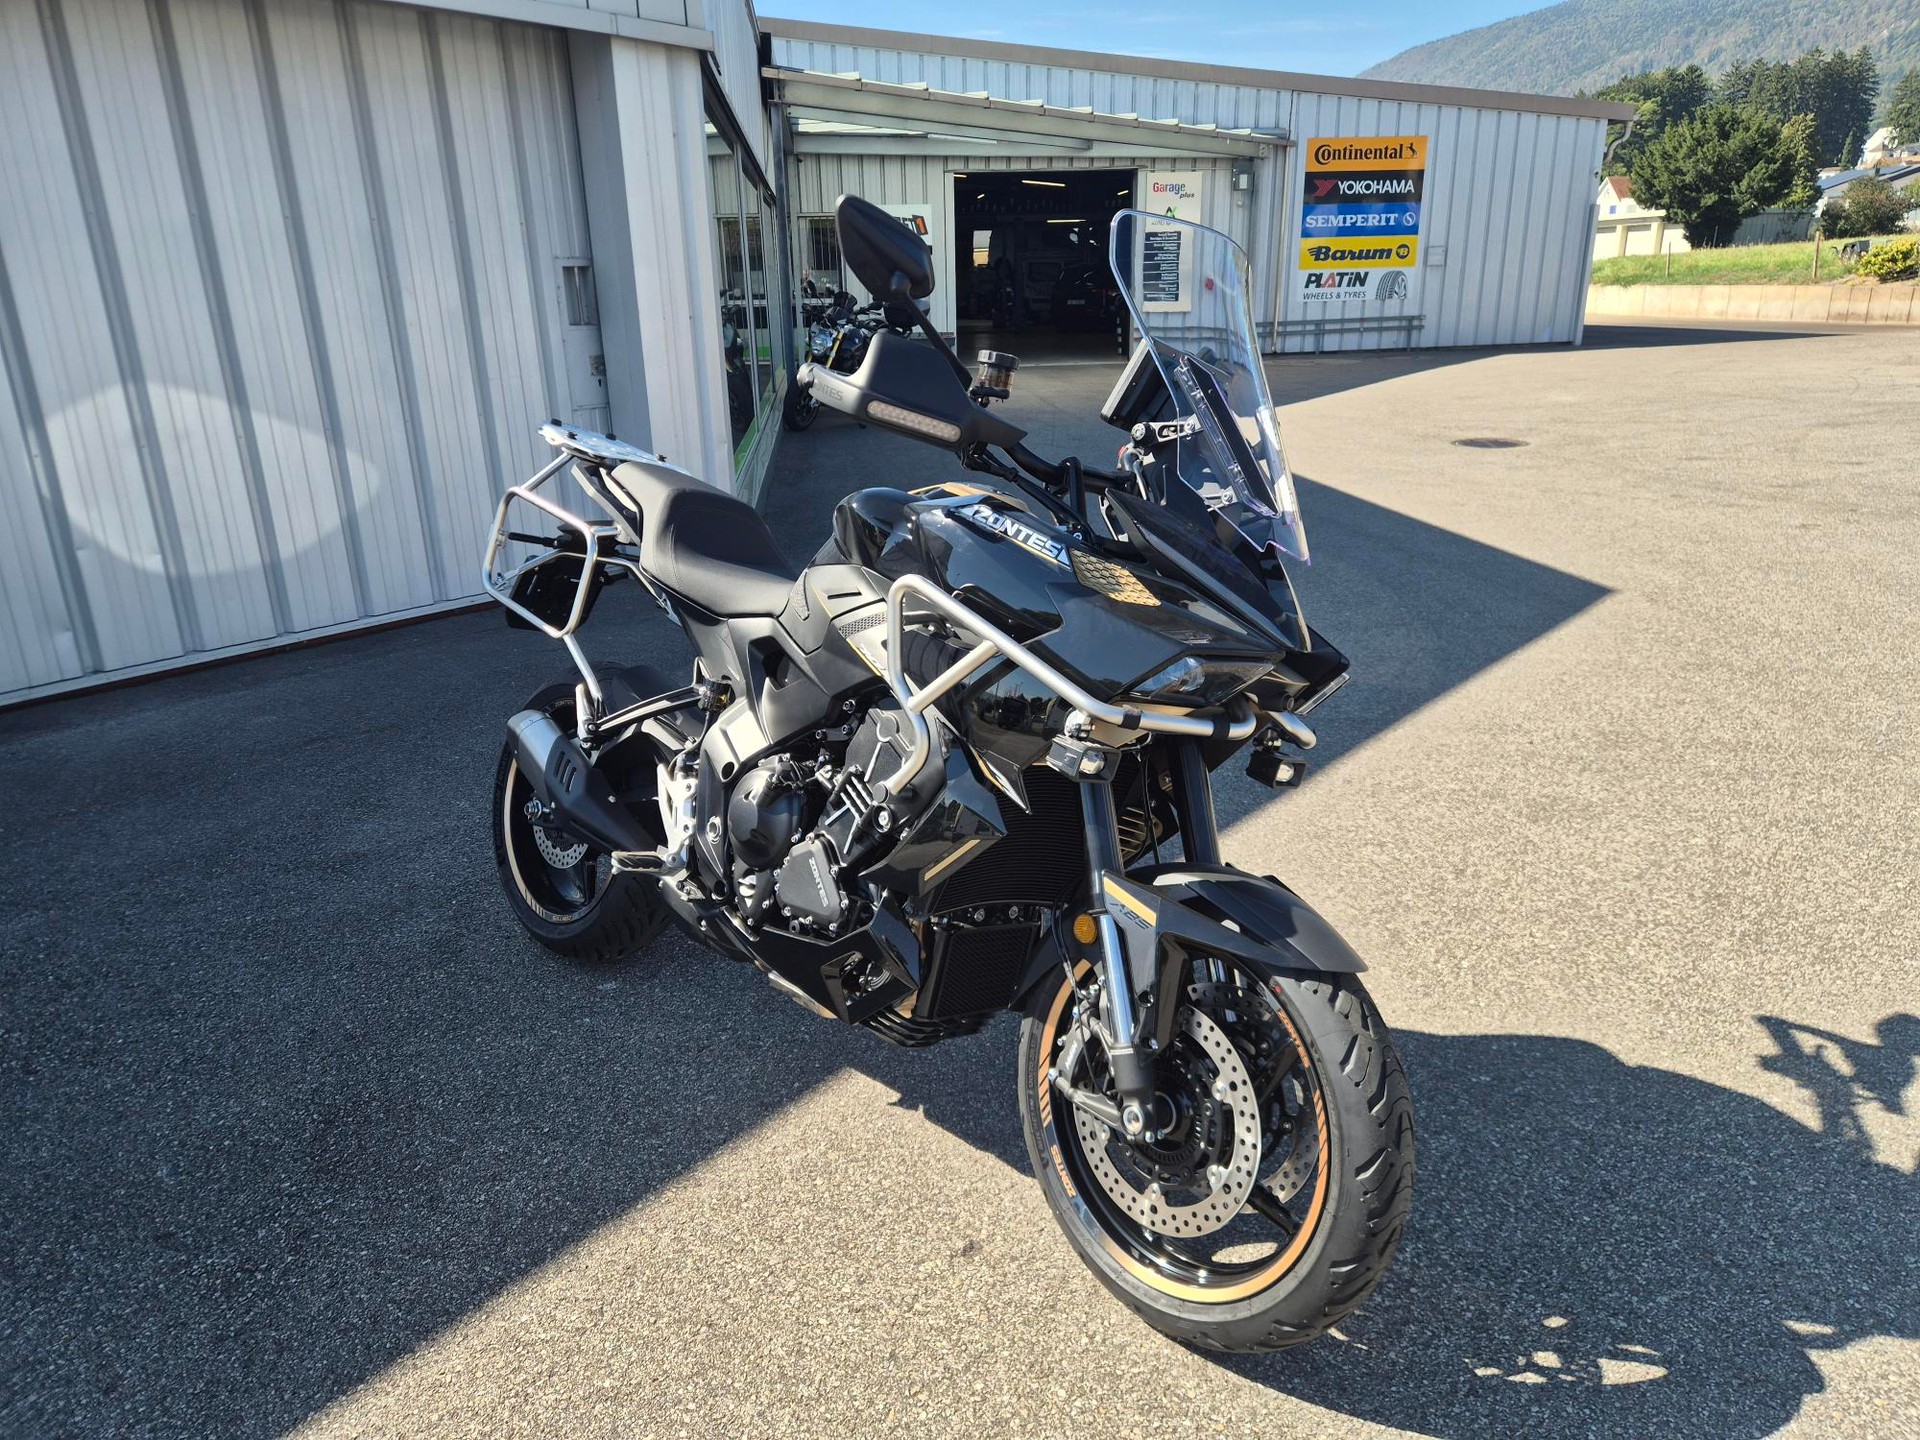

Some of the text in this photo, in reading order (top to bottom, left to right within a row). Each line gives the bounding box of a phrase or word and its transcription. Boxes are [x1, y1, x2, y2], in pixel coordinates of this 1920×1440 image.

[1314, 144, 1403, 165] Continental
[1152, 182, 1186, 195] Garage
[1179, 190, 1195, 199] plus
[1338, 179, 1415, 194] YOKOHAMA
[1305, 213, 1398, 228] SEMPERIT
[1309, 245, 1393, 262] Barum
[1303, 291, 1367, 301] WHEELS & TYRES
[973, 504, 1062, 558] ZONTES
[809, 857, 829, 907] ZONTES
[1051, 1144, 1077, 1198] ZONTES
